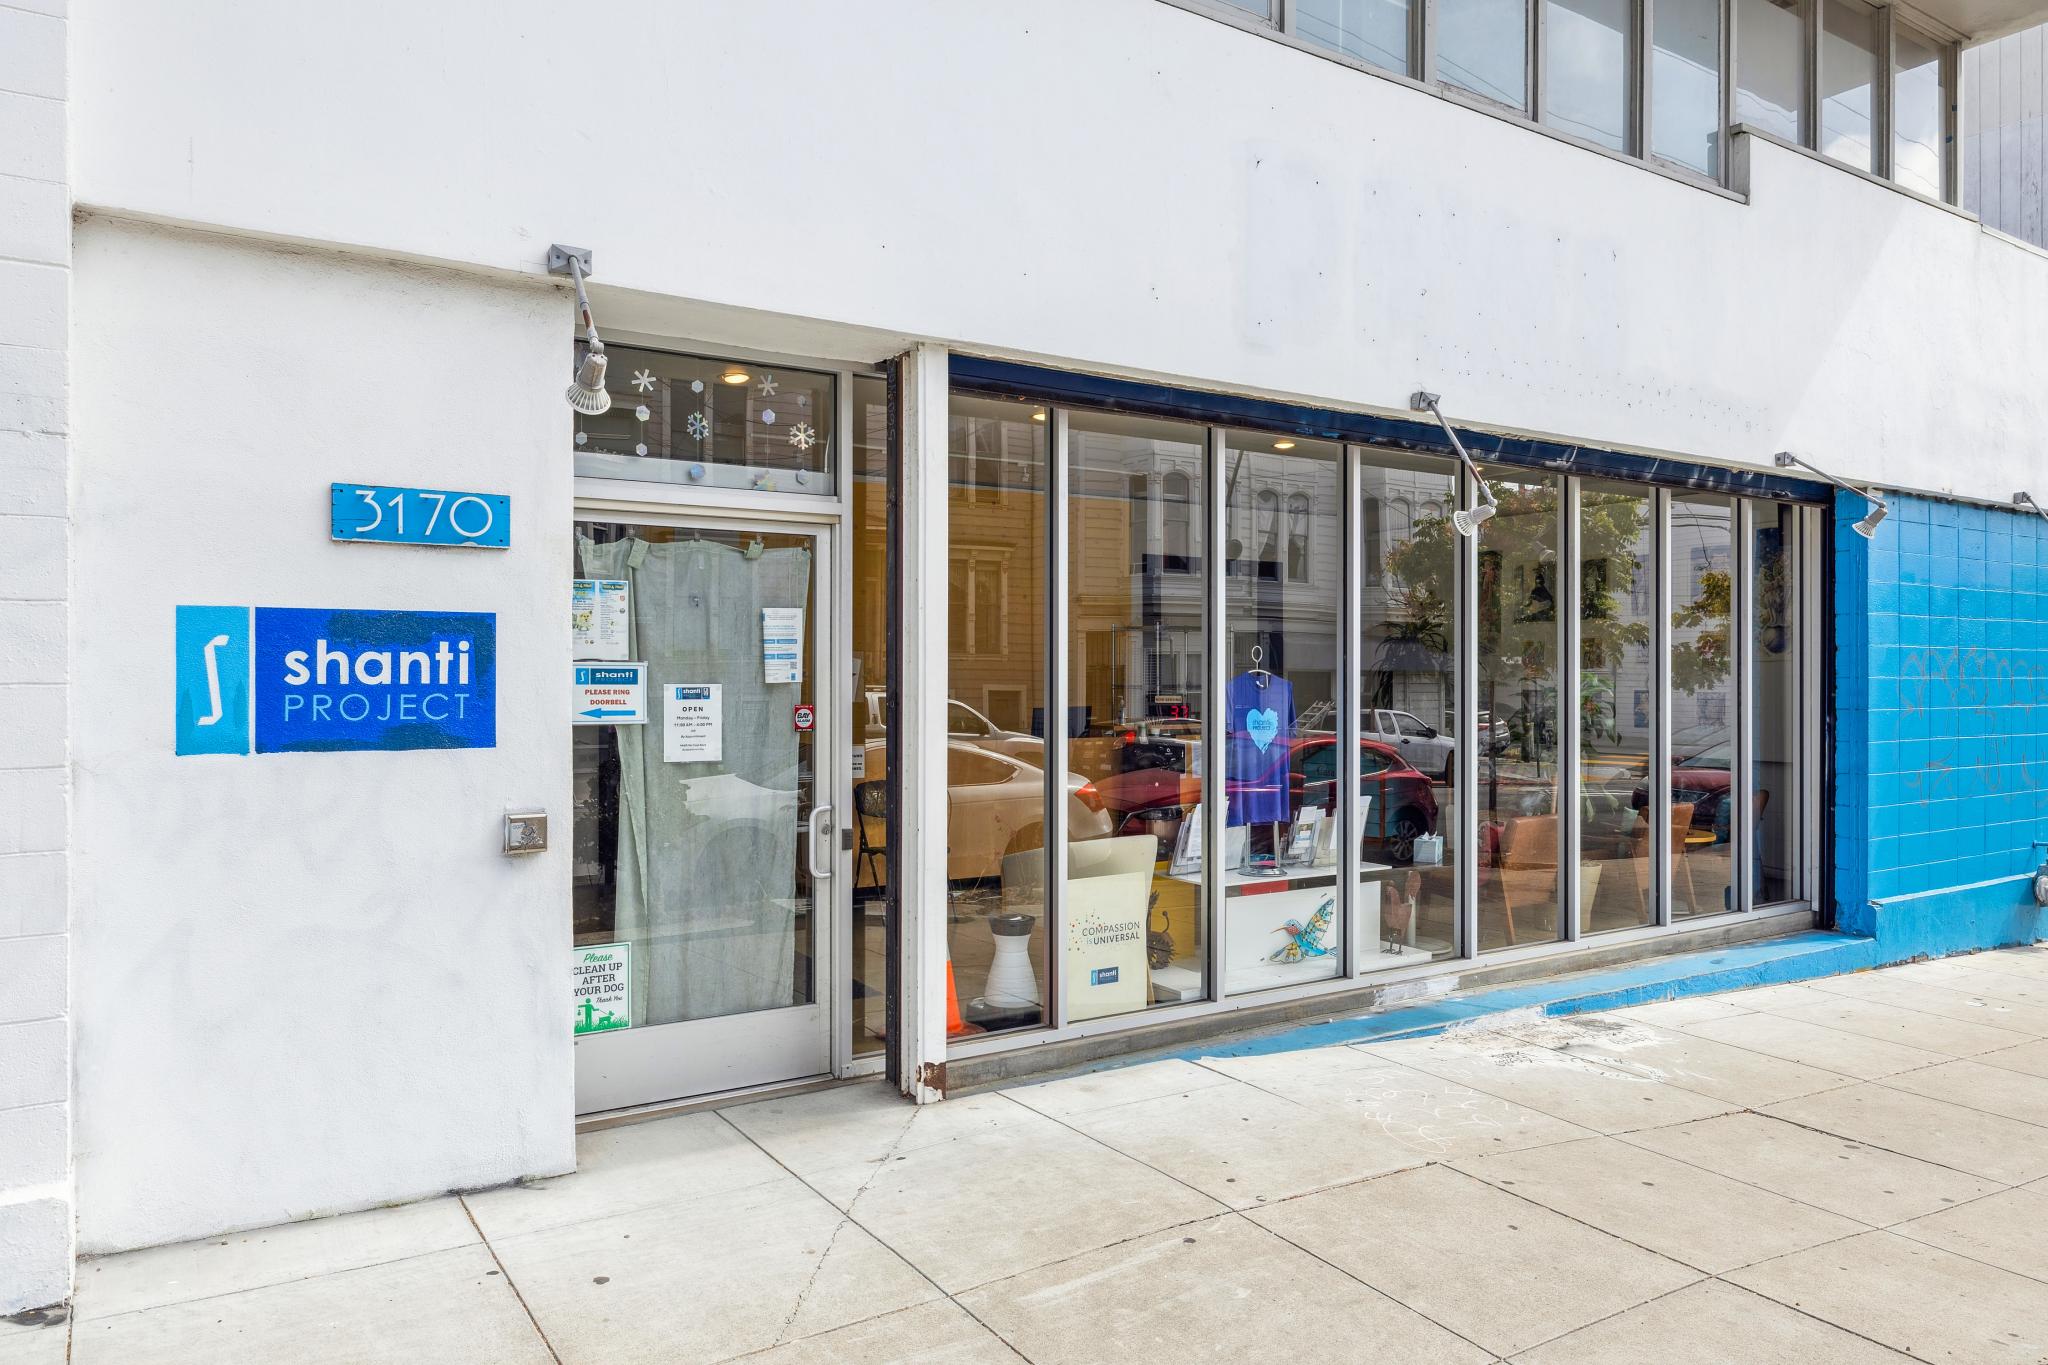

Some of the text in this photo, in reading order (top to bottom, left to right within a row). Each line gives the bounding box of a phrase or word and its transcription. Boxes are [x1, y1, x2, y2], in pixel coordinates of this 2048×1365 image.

[355, 489, 493, 537] 3170
[283, 639, 470, 685] shanti
[284, 693, 470, 721] PROJECT
[1170, 704, 1189, 719] 37
[1082, 921, 1141, 937] COMPASSION
[1093, 931, 1141, 945] UNIVERSAL
[583, 953, 613, 963] Please
[573, 962, 623, 976] CLEAN UP
[1099, 969, 1117, 978] shanti
[582, 974, 616, 985] AFTER
[574, 983, 625, 997] YOUR DOG
[596, 996, 612, 1004] Thank
